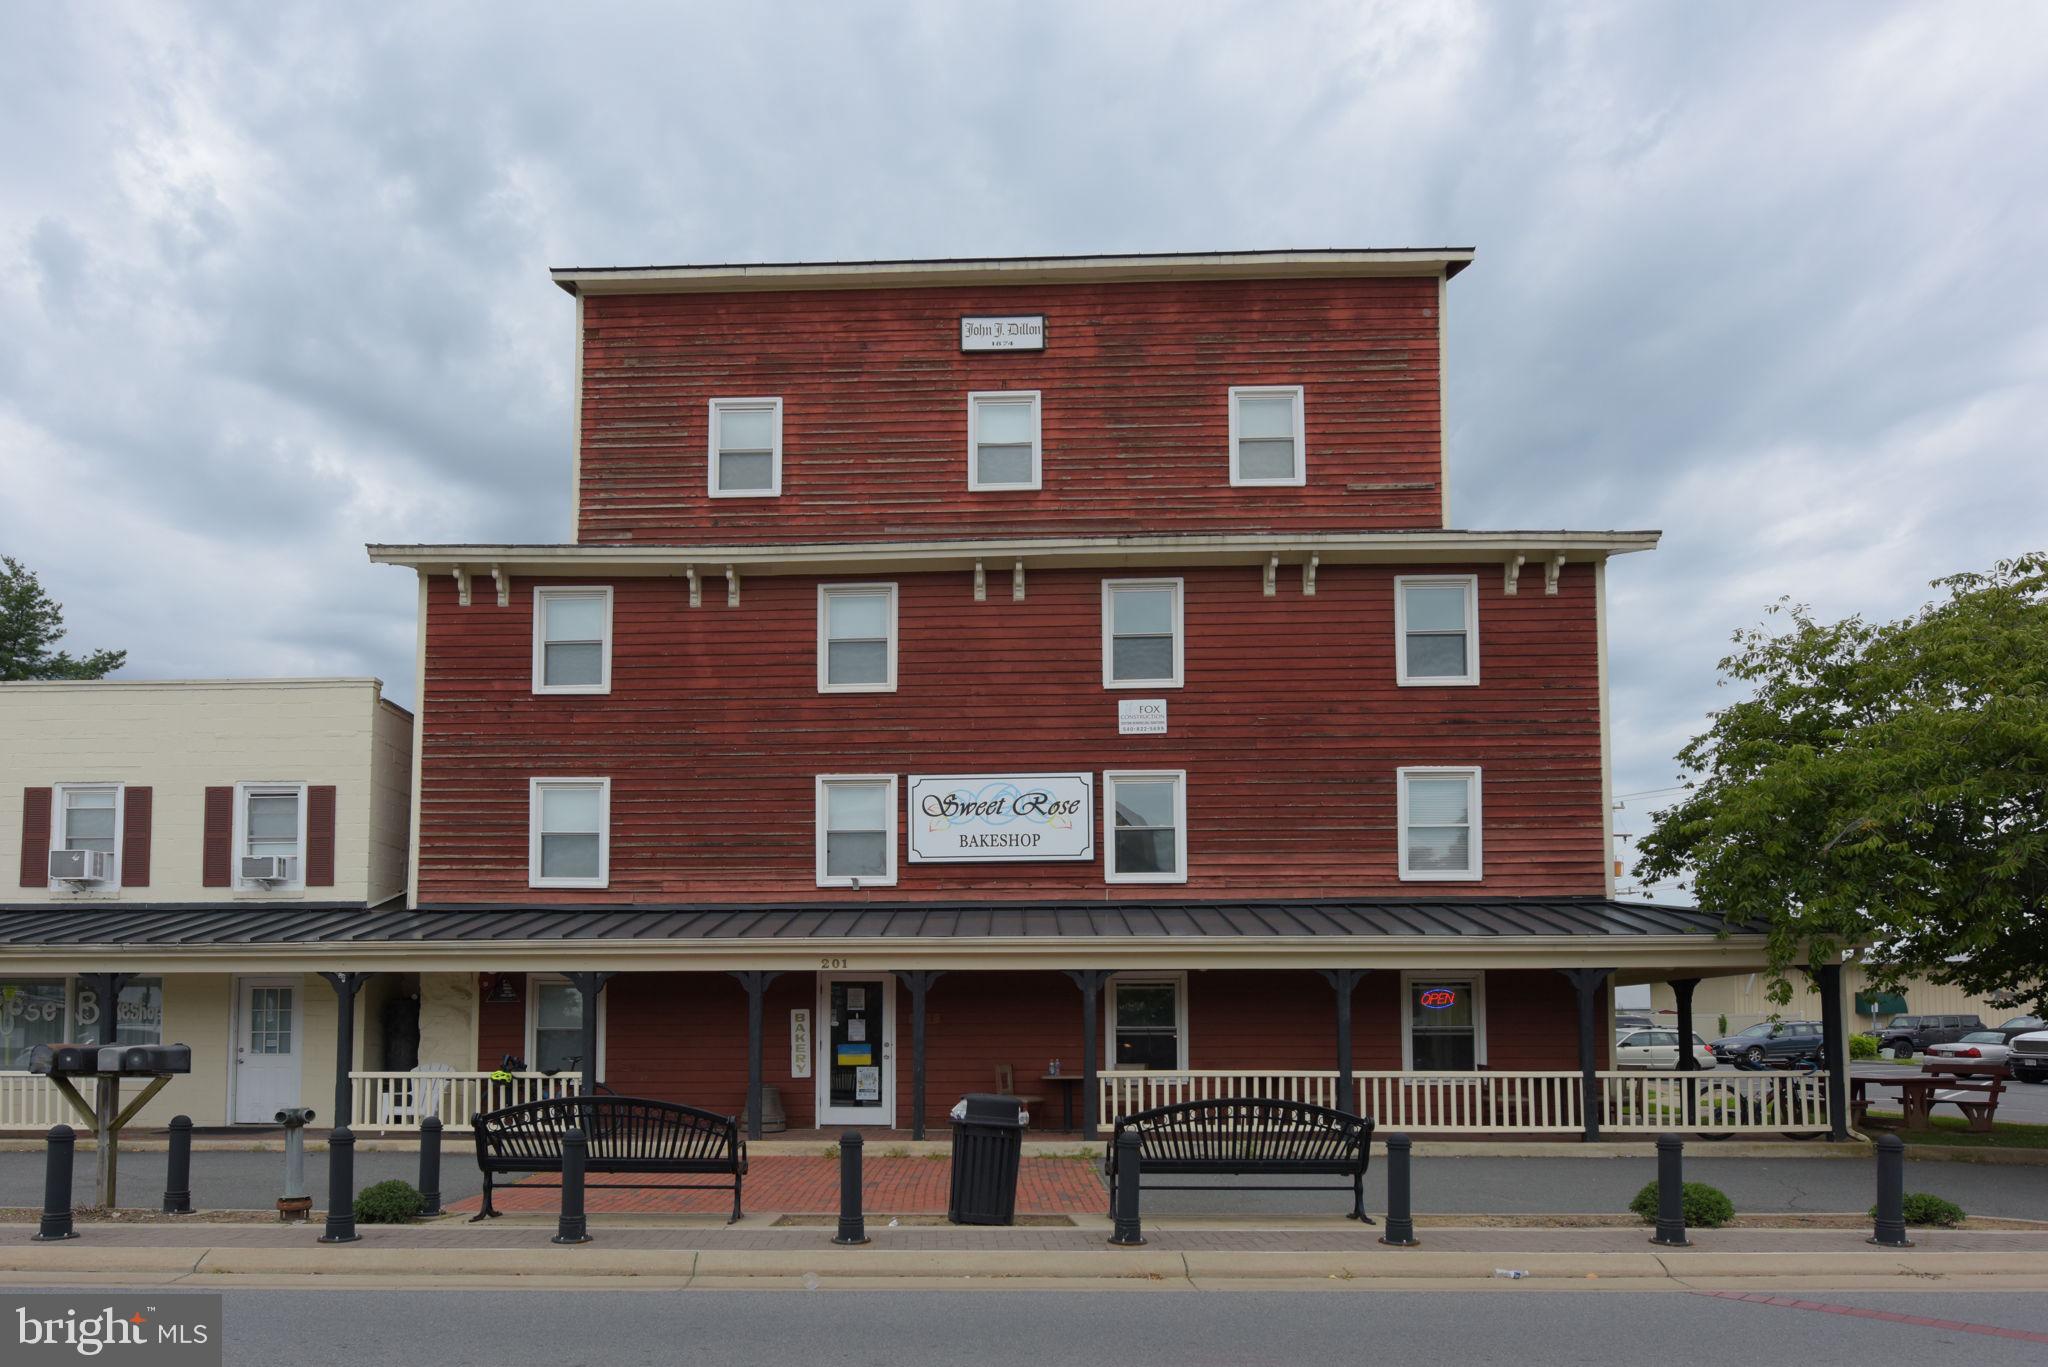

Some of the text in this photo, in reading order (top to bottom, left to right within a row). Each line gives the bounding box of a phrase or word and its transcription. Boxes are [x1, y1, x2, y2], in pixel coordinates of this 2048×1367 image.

[965, 322, 1041, 338] John J. Dillon
[1139, 705, 1160, 714] FOX
[922, 792, 1081, 817] Sweet Rose
[959, 833, 1041, 848] BAKESHOP
[821, 958, 848, 969] 201
[1421, 991, 1455, 1006] OPEN
[794, 1012, 807, 1074] BAKERY
